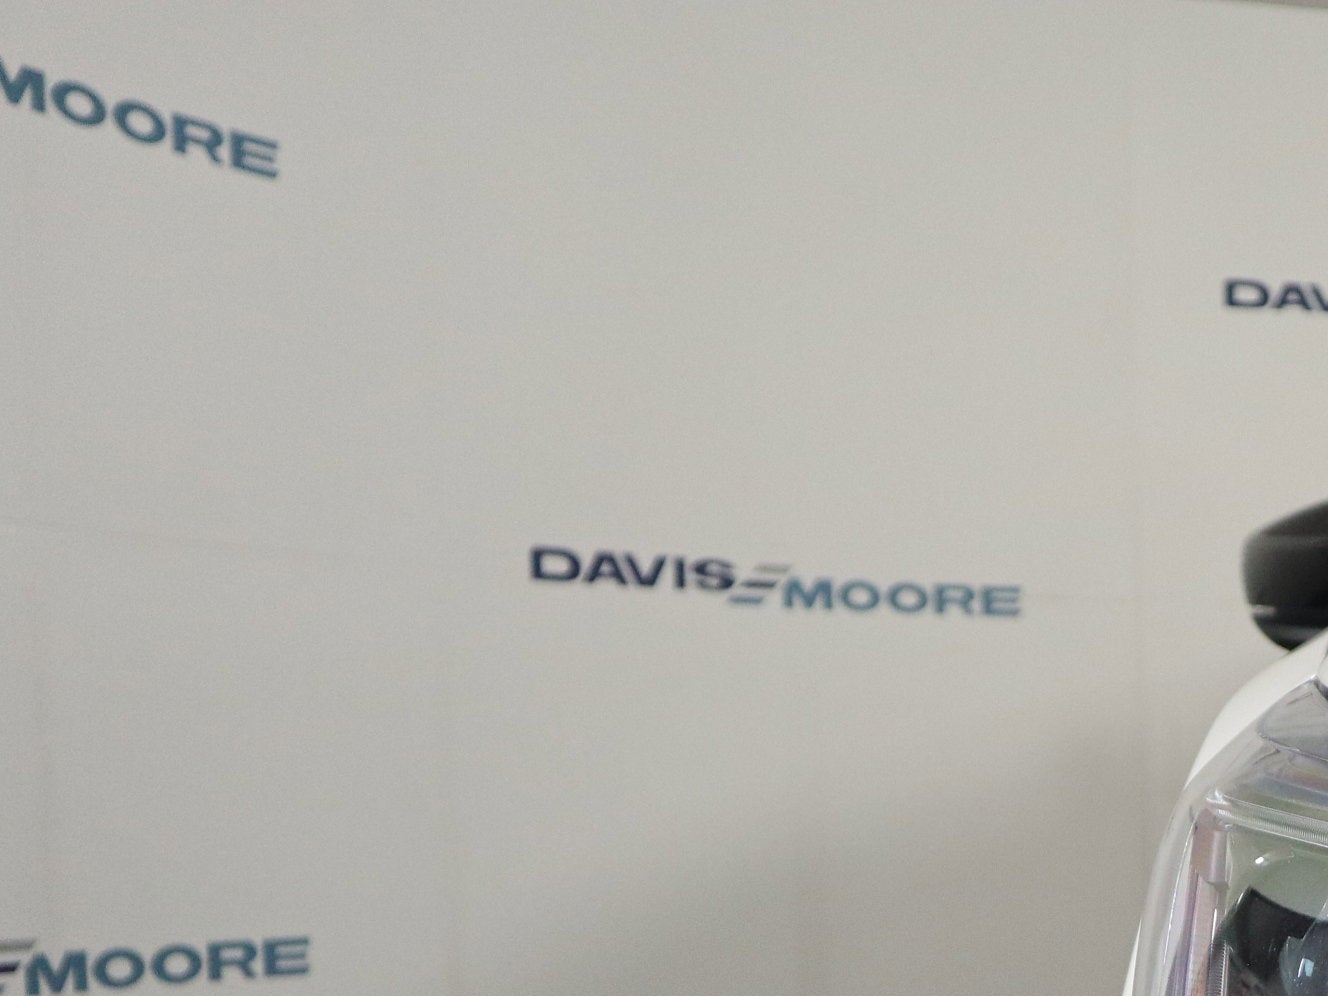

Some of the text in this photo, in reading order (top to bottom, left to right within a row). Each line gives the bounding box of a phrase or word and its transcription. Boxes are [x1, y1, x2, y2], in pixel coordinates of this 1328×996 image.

[0, 59, 279, 179] MOORE
[528, 545, 1023, 618] DAVIS MOORE
